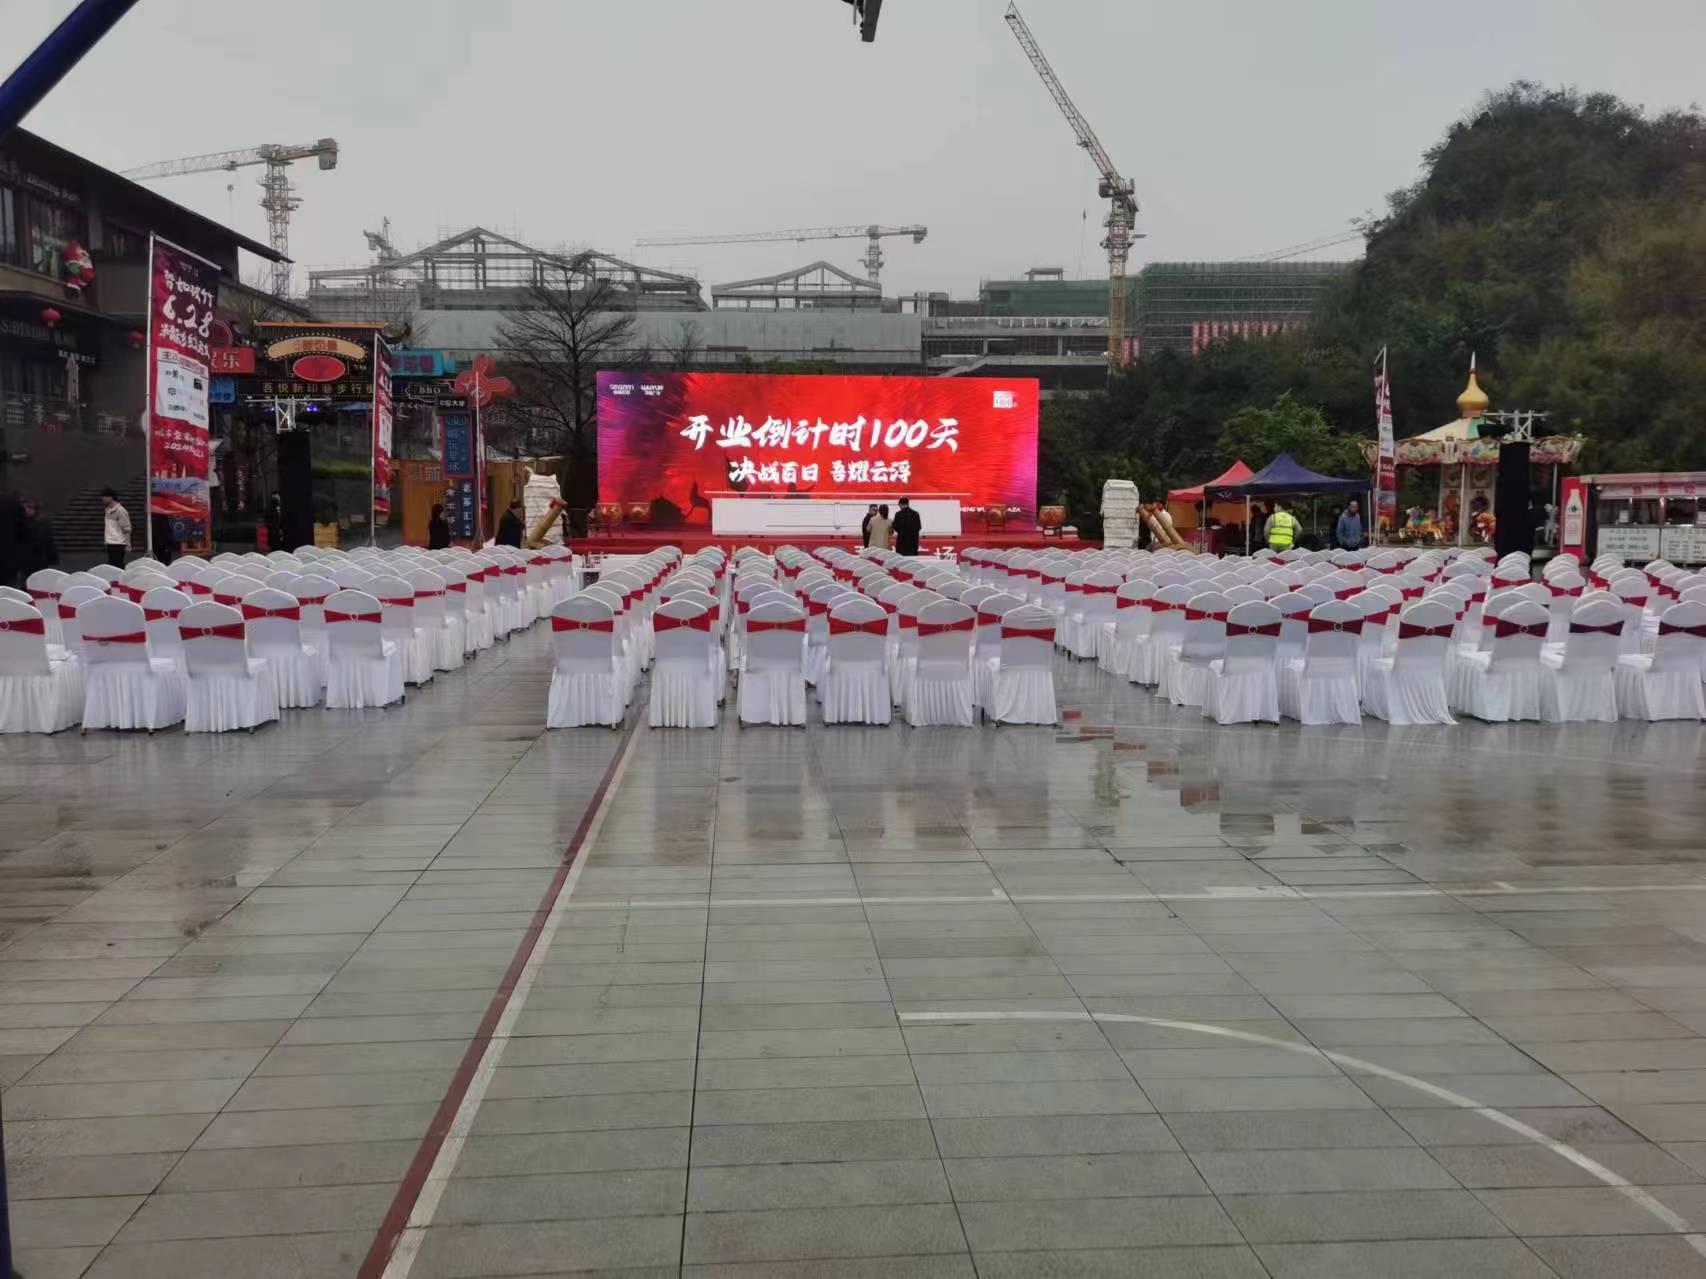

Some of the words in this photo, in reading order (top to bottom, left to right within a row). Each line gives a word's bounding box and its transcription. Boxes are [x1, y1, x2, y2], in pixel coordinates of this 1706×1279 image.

[162, 294, 214, 338] 6.28
[679, 414, 960, 454] 开业倒计时100天
[729, 456, 820, 484] 决战百日
[830, 459, 912, 484] 吾耀云浮
